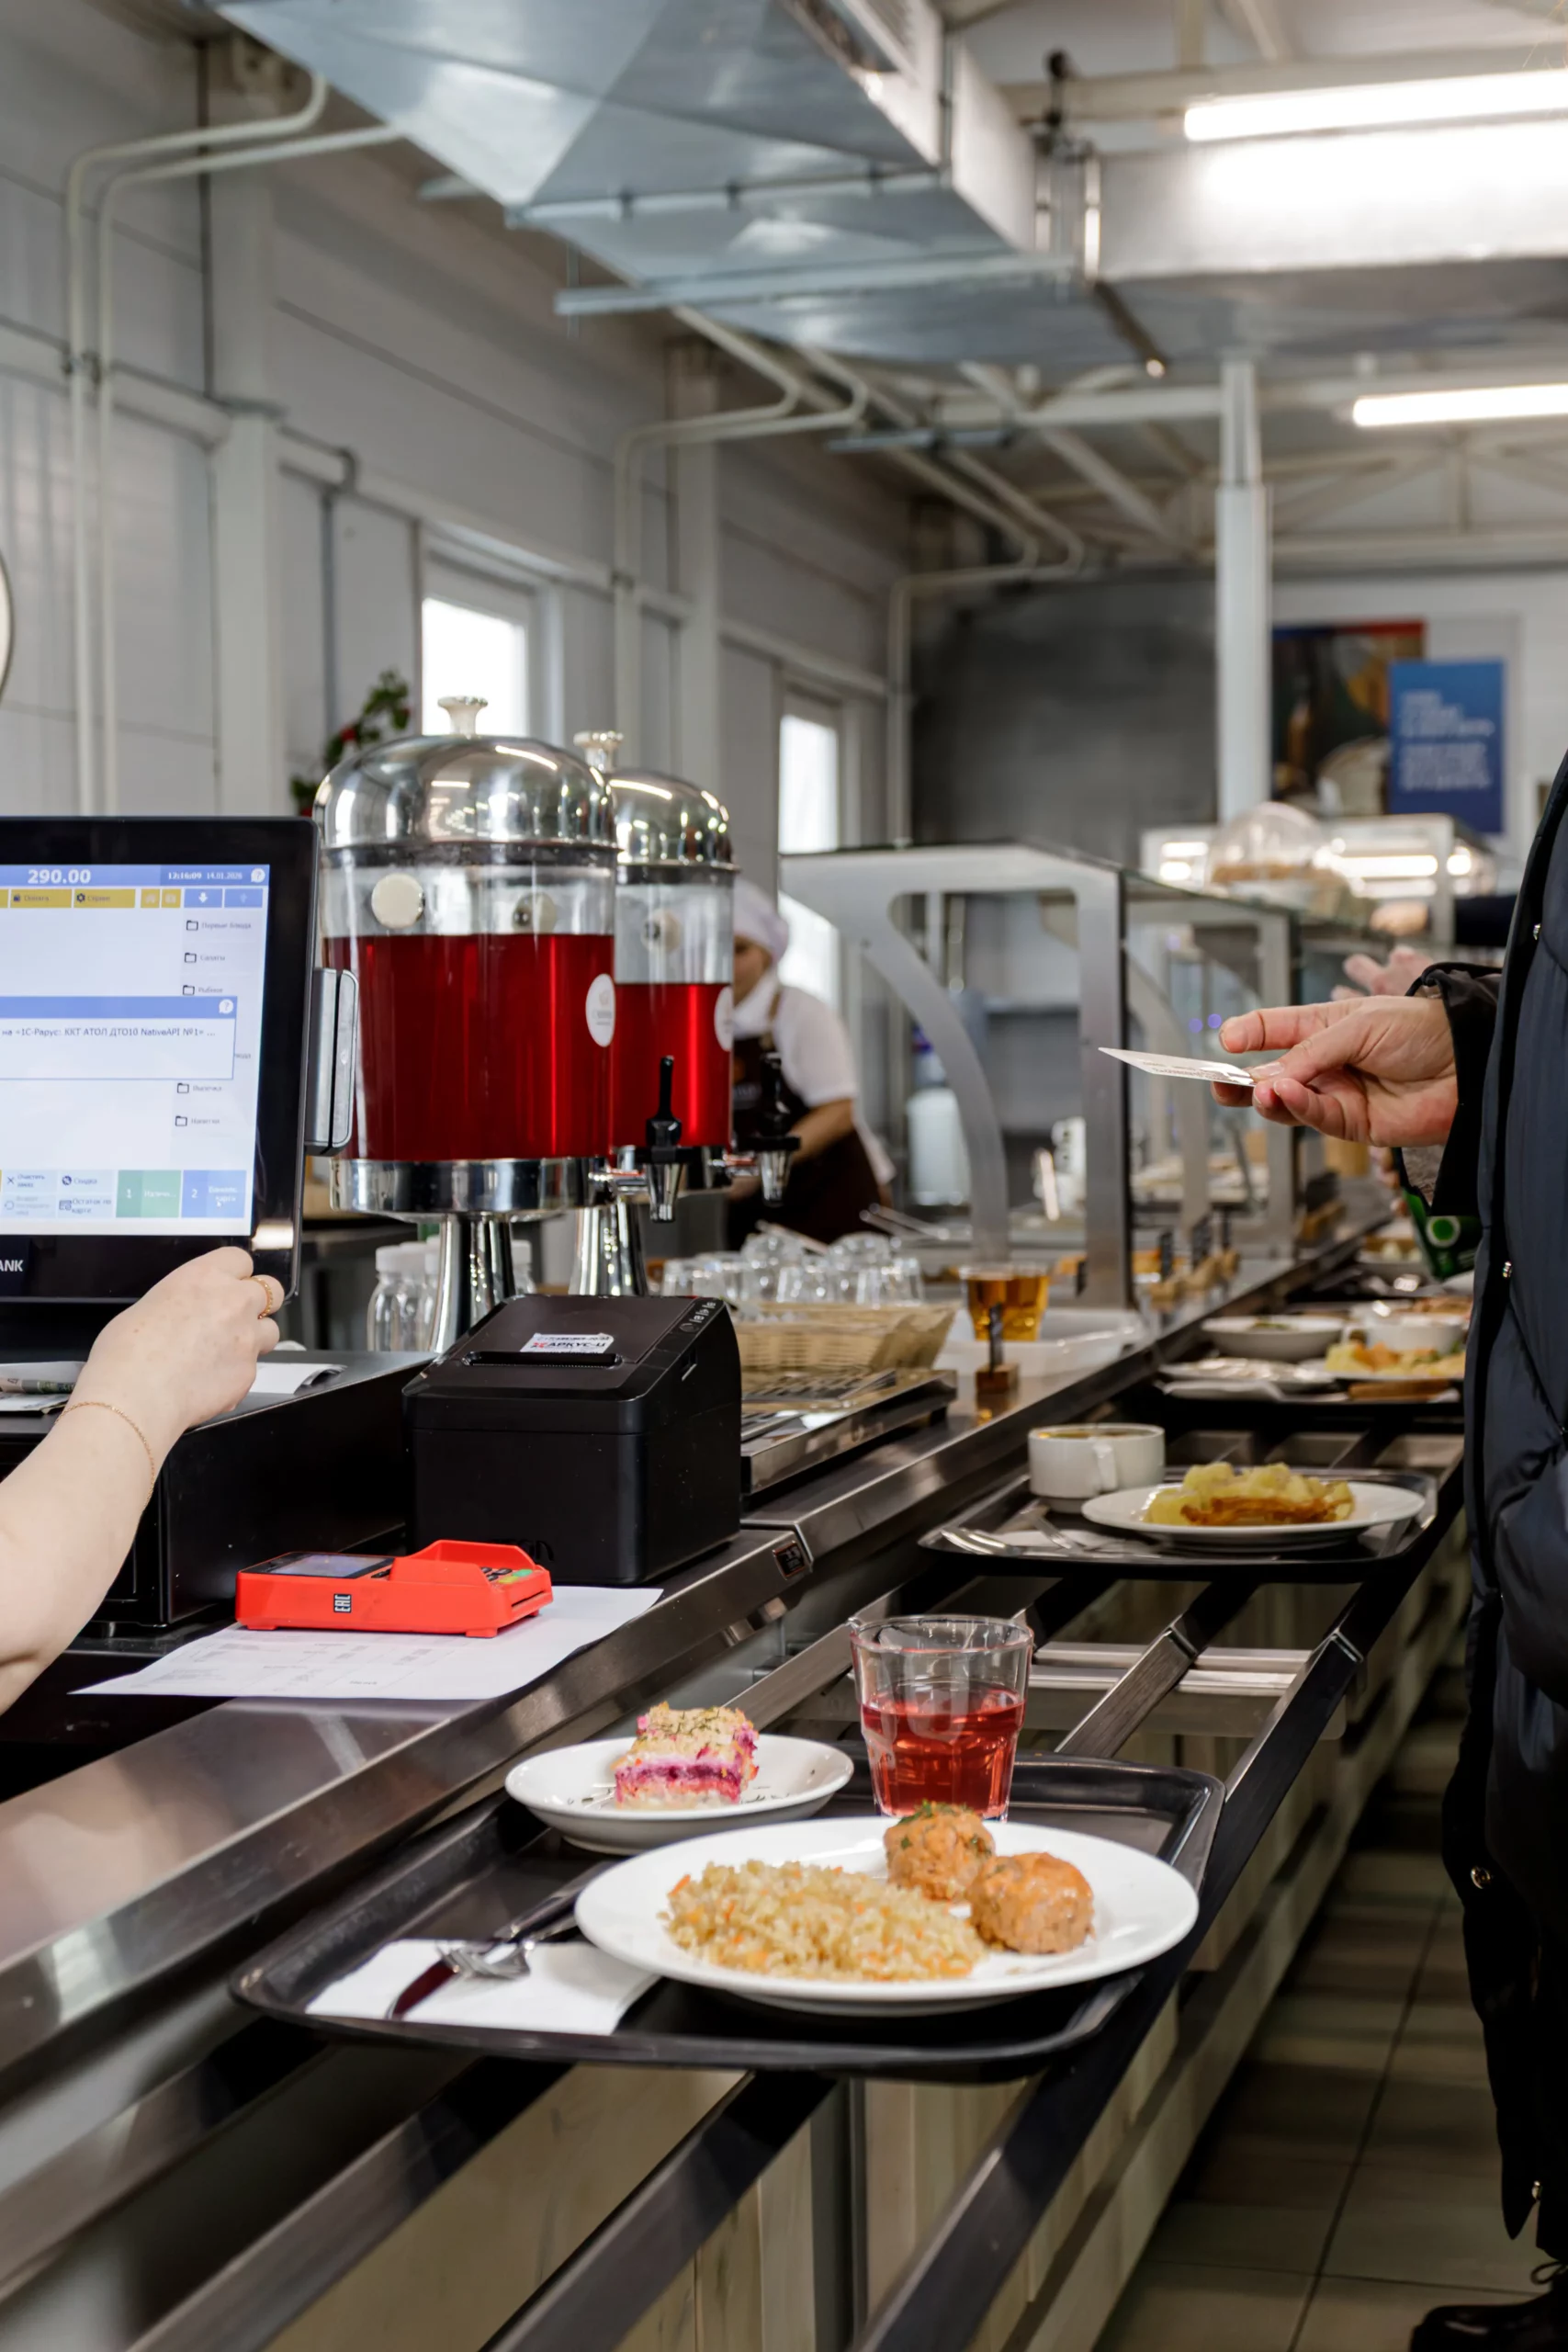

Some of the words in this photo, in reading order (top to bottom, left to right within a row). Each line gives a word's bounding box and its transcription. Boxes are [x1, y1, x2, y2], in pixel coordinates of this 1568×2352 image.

[28, 868, 91, 884] 290.00
[141, 1028, 180, 1036] NativeAPI
[126, 1188, 132, 1199] 1
[191, 1188, 198, 1199] 2
[334, 1594, 351, 1612] EAC
